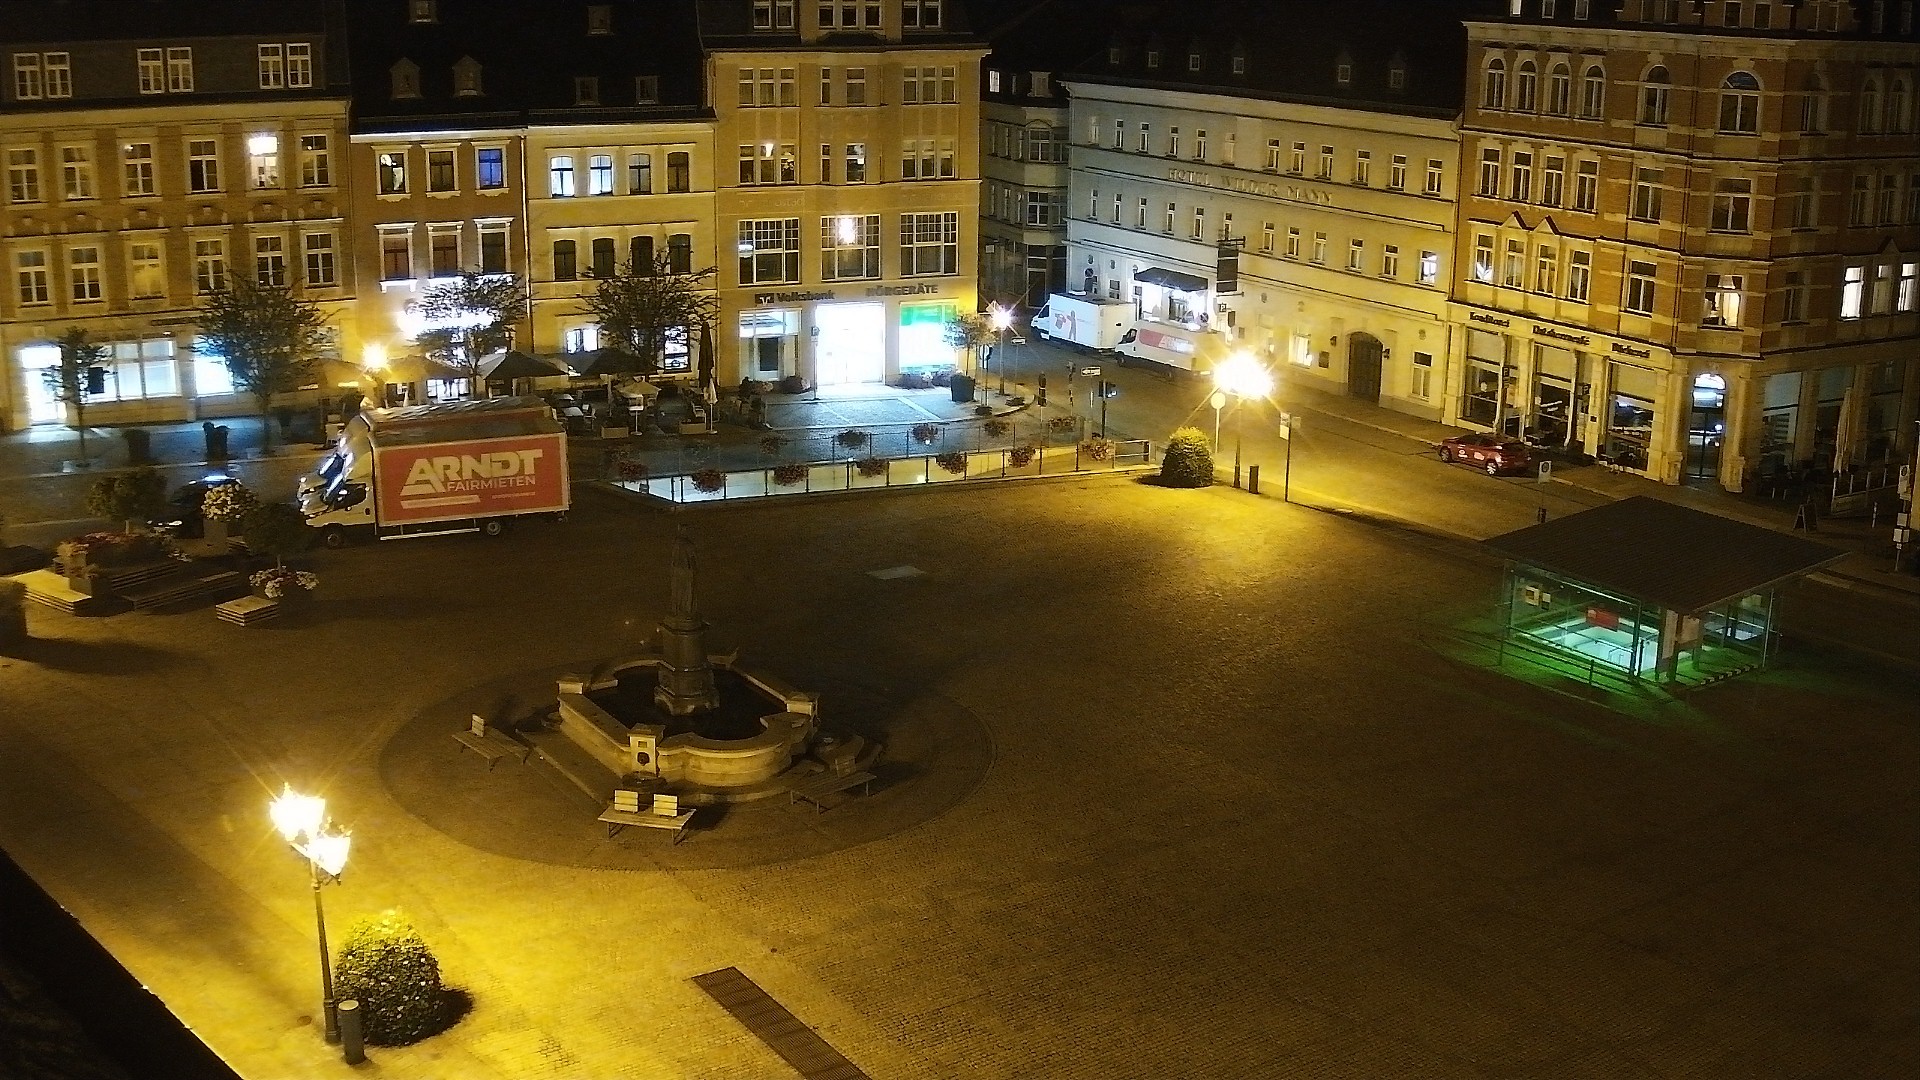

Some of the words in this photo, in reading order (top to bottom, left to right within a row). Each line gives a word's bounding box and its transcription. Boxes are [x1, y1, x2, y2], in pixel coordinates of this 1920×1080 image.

[1168, 168, 1211, 186] HOTEL
[1221, 175, 1279, 197] WILDER
[1287, 185, 1333, 206] MANN
[776, 289, 836, 302] Volksbank
[865, 282, 939, 297] HÖRGERÄTE
[400, 449, 543, 496] ARNDT
[447, 475, 536, 492] FAIRMIETEN
